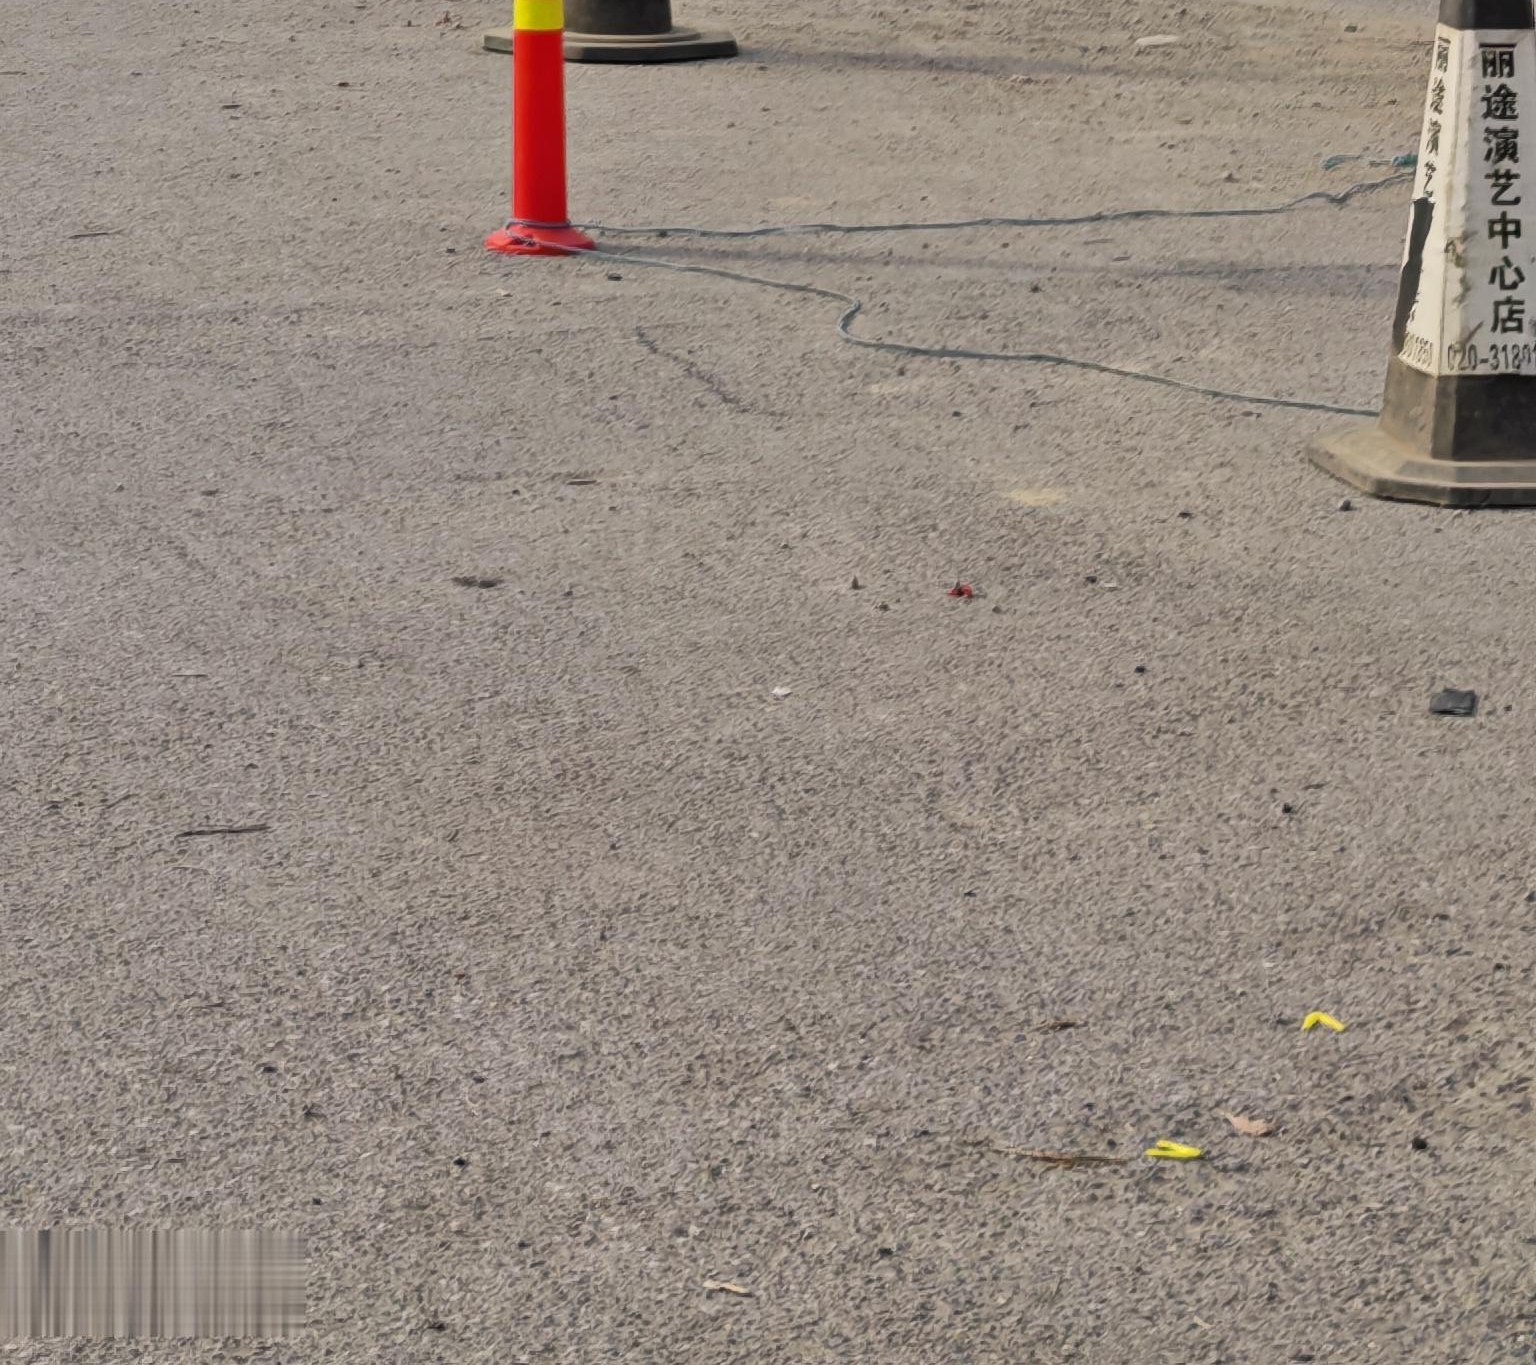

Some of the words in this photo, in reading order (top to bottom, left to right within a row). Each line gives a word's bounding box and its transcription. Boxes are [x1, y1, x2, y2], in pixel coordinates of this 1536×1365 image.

[1478, 43, 1525, 334] 丽途演艺中心店
